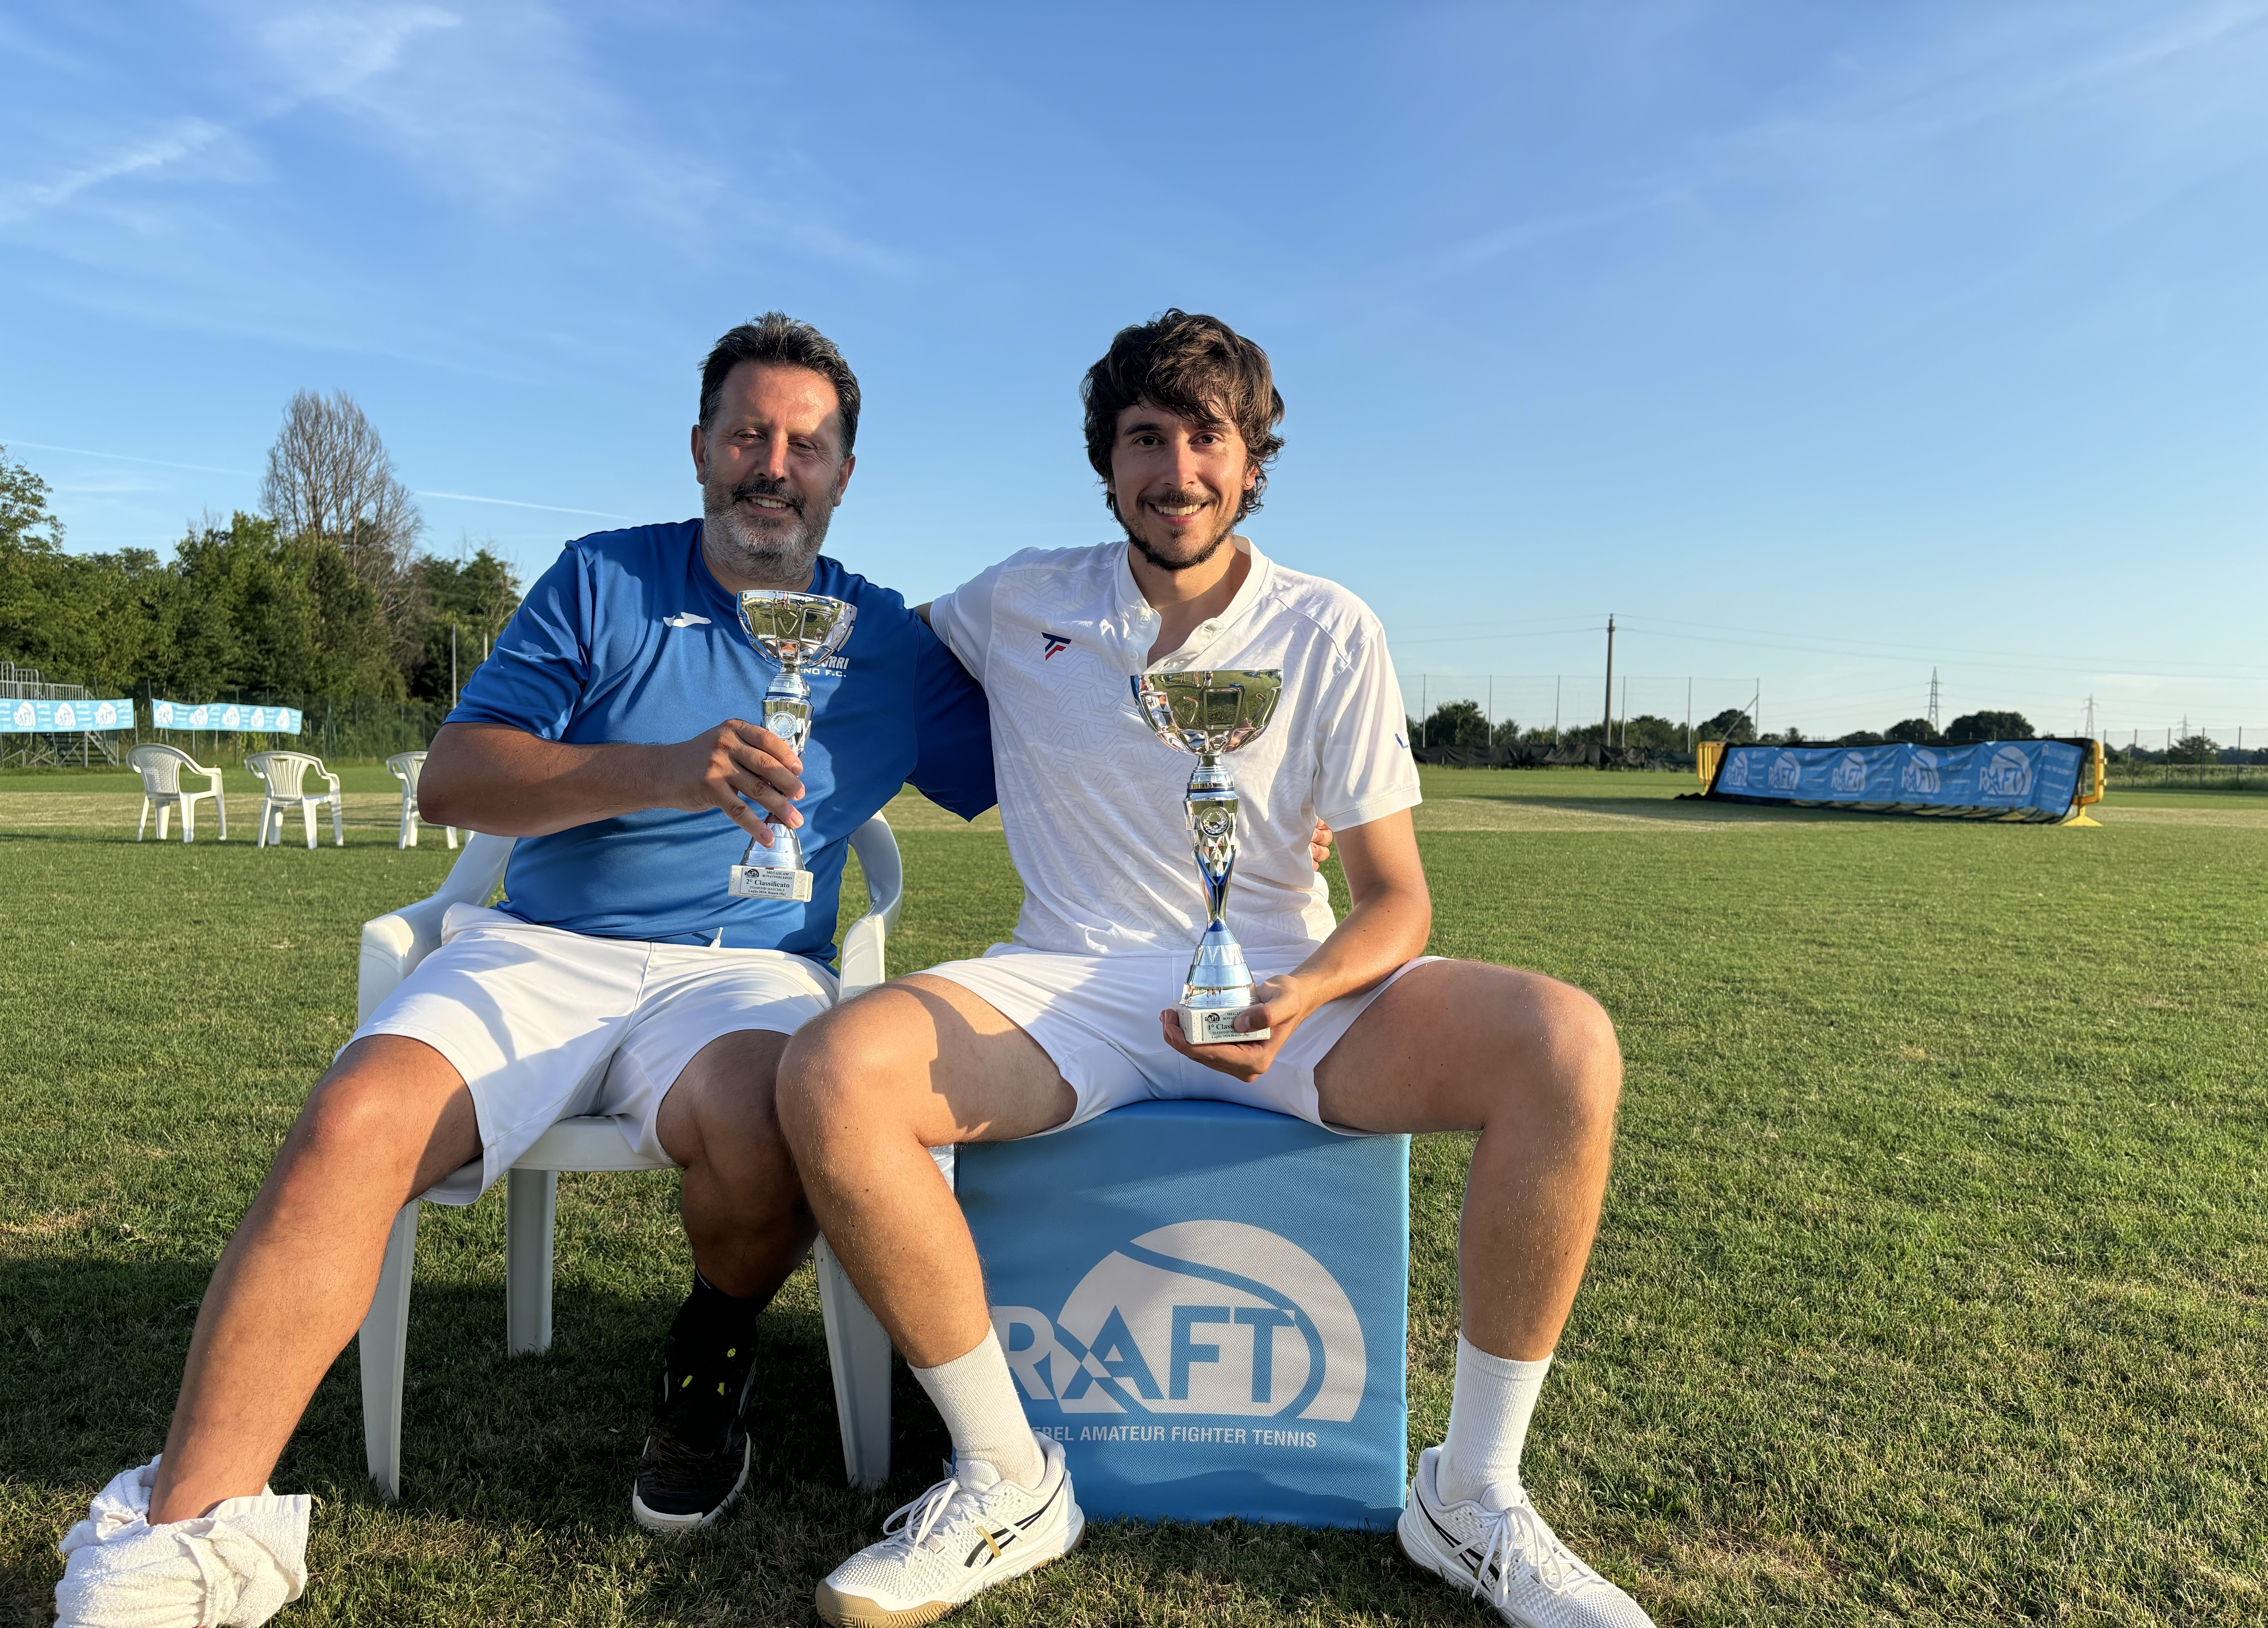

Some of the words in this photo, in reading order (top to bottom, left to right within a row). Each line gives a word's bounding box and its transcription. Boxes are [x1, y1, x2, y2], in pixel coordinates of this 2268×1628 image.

[817, 656, 849, 669] URRI
[754, 880, 789, 888] Classificato
[992, 1305, 1295, 1403] RAFT
[1080, 1427, 1165, 1441] AMATEUR
[1172, 1427, 1247, 1445] FIGHTER
[1253, 1430, 1317, 1448] TENNIS
